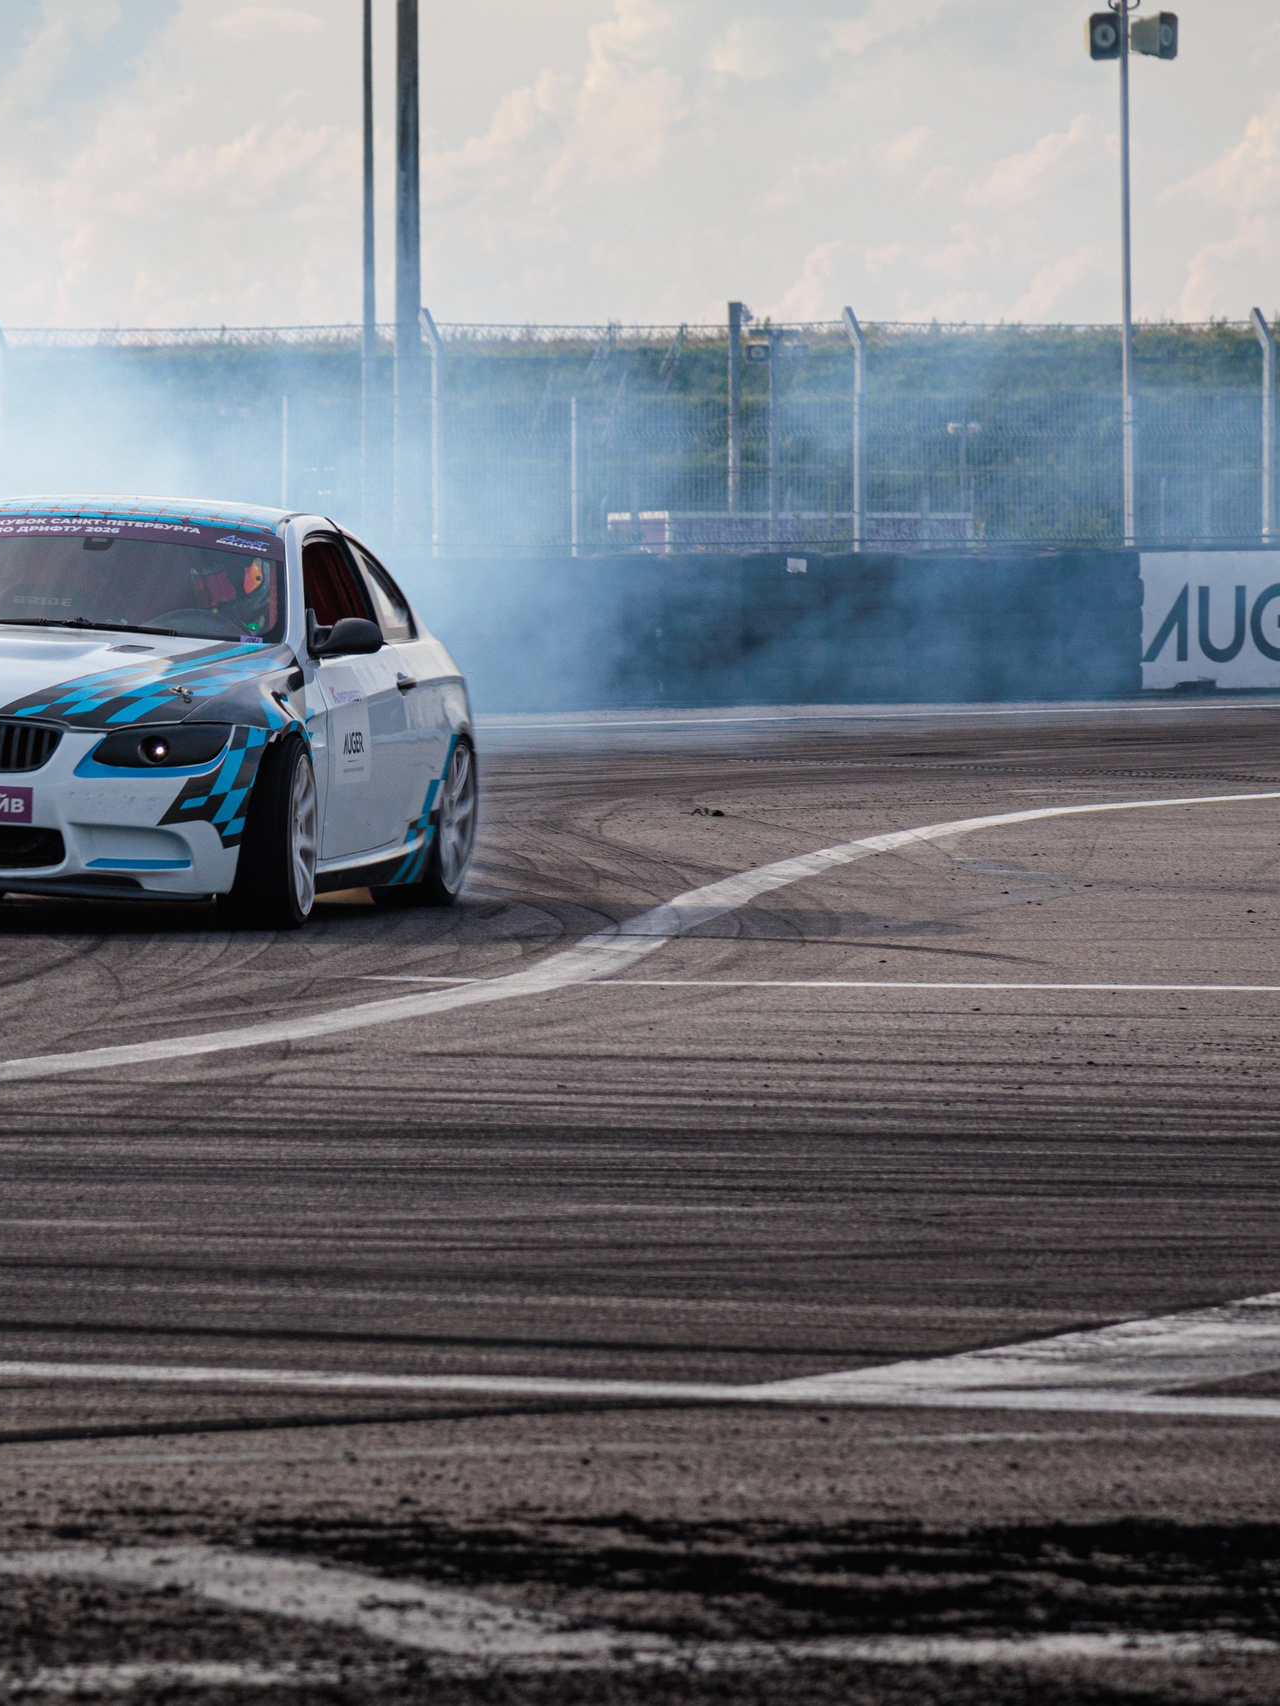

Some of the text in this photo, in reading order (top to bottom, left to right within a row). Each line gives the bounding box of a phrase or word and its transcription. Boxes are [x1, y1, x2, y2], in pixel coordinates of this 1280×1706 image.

[50, 518, 201, 535] САНКТ-ПЕТЕРБУРГА
[84, 526, 120, 534] 2026
[343, 732, 364, 755] AUGER
